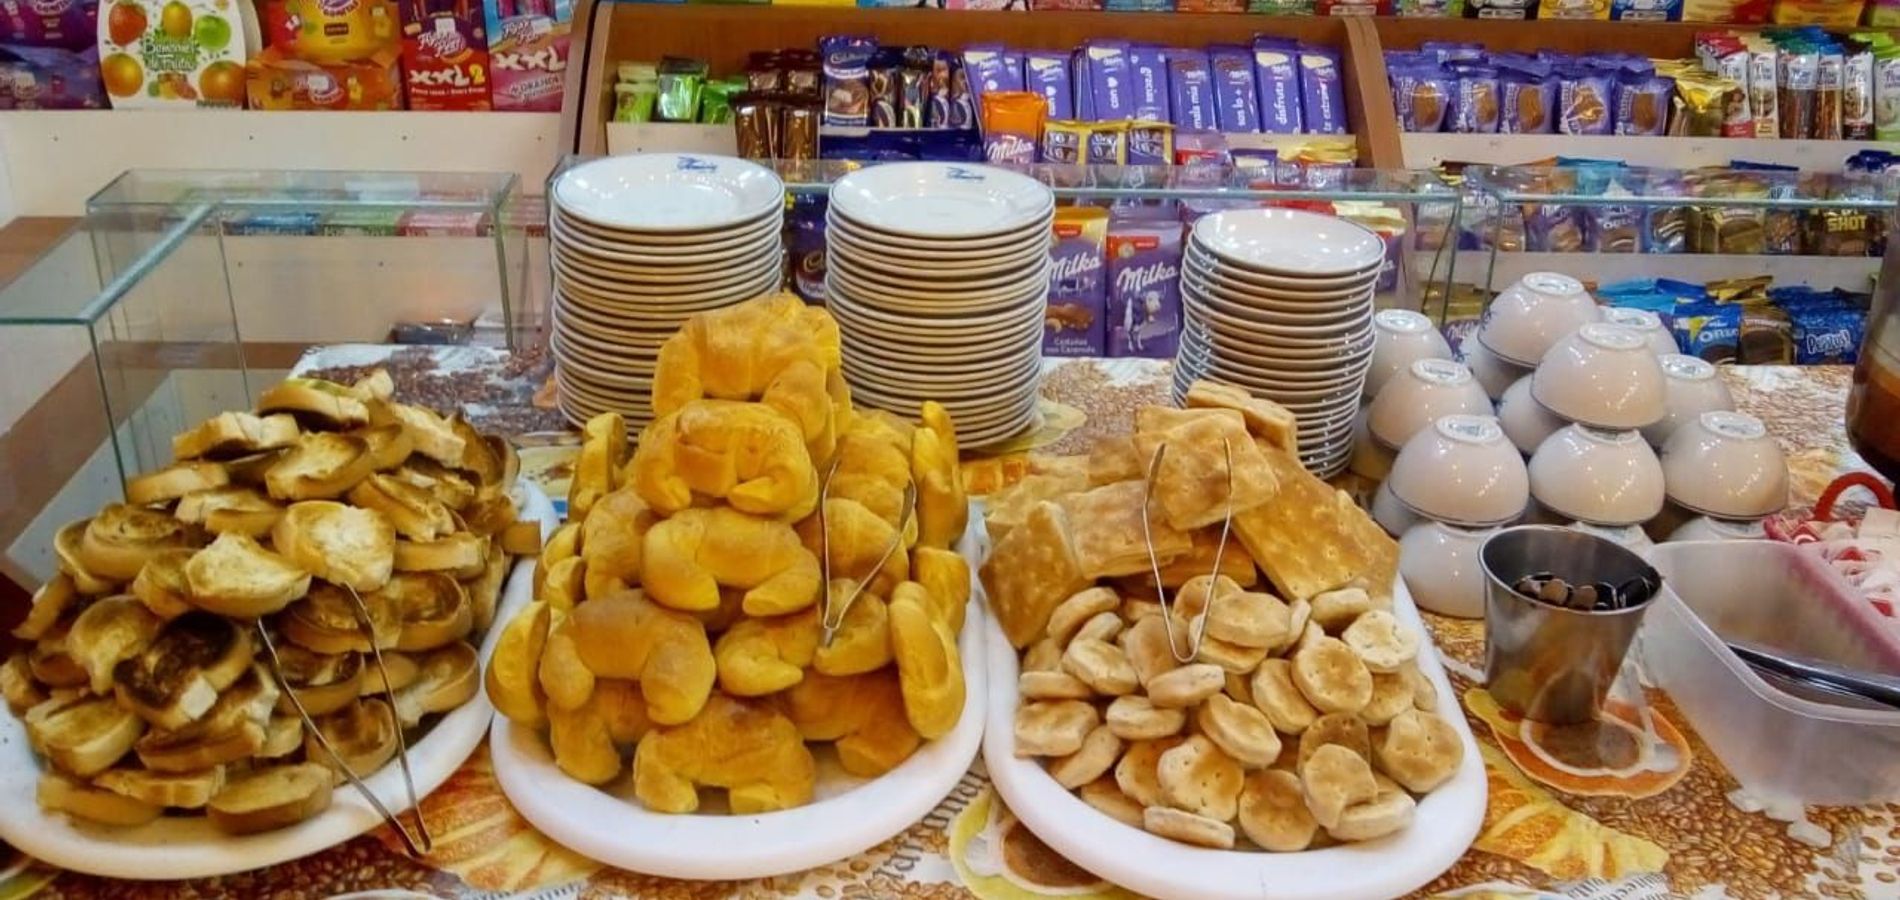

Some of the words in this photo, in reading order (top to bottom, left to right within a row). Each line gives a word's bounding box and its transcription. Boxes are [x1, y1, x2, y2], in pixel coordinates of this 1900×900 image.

[494, 46, 566, 72] XXL
[409, 64, 470, 87] XXL
[1110, 89, 1119, 109] con
[986, 138, 1034, 161] Milka
[1826, 215, 1868, 232] SHOT
[1048, 251, 1101, 281] Milka
[1116, 261, 1178, 293] Milka
